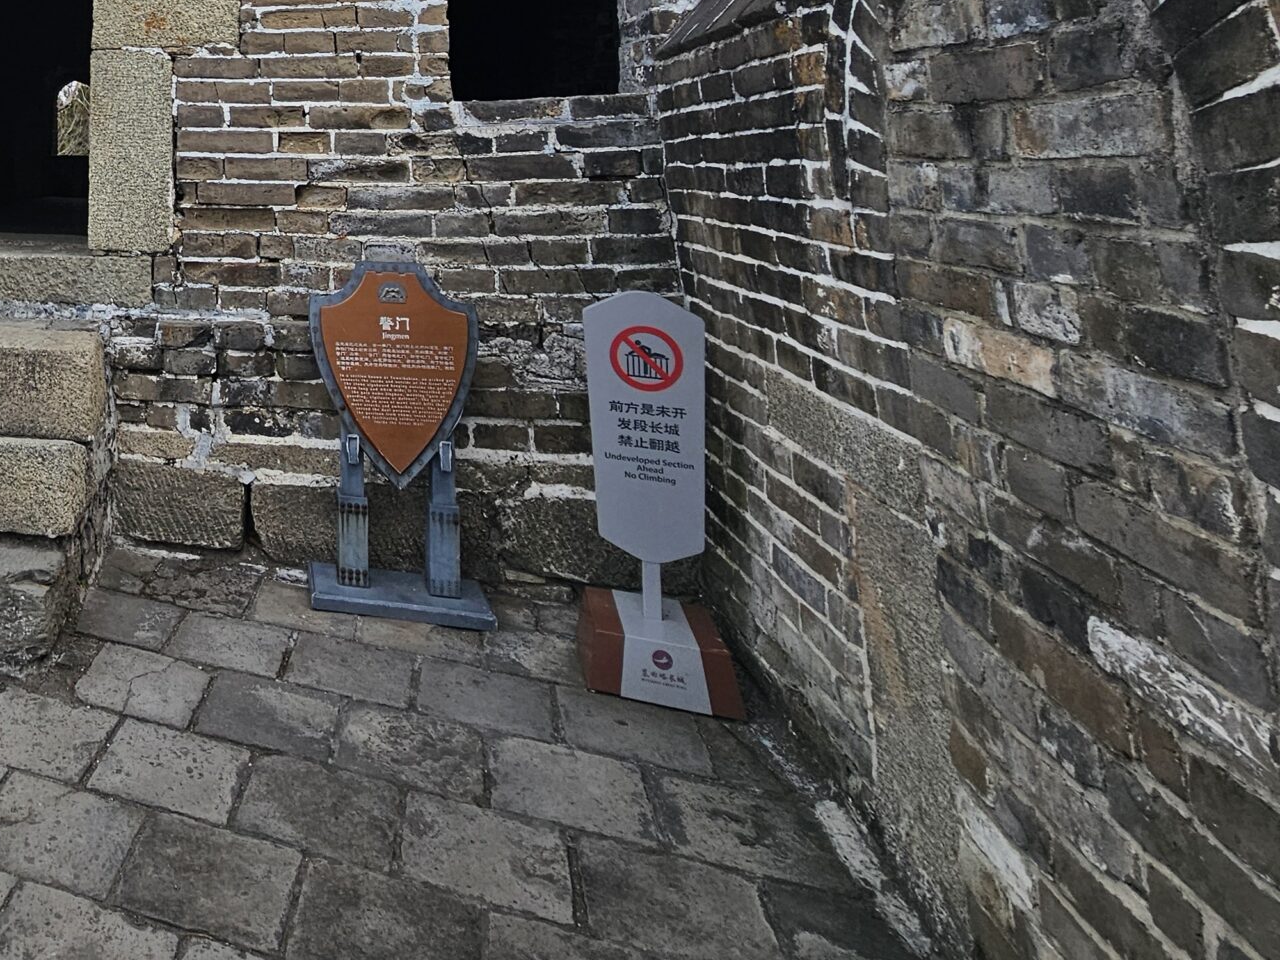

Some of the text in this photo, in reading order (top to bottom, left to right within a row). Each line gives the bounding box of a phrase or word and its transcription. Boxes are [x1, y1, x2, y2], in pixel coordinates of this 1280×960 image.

[382, 331, 410, 341] Jingmen
[609, 400, 687, 419] 前方是未开
[617, 417, 680, 436] 发段长城
[618, 434, 681, 454] 禁止翻越
[604, 451, 695, 470] Undeveloped Section
[636, 464, 664, 474] Ahead
[624, 470, 677, 486] No Climbing
